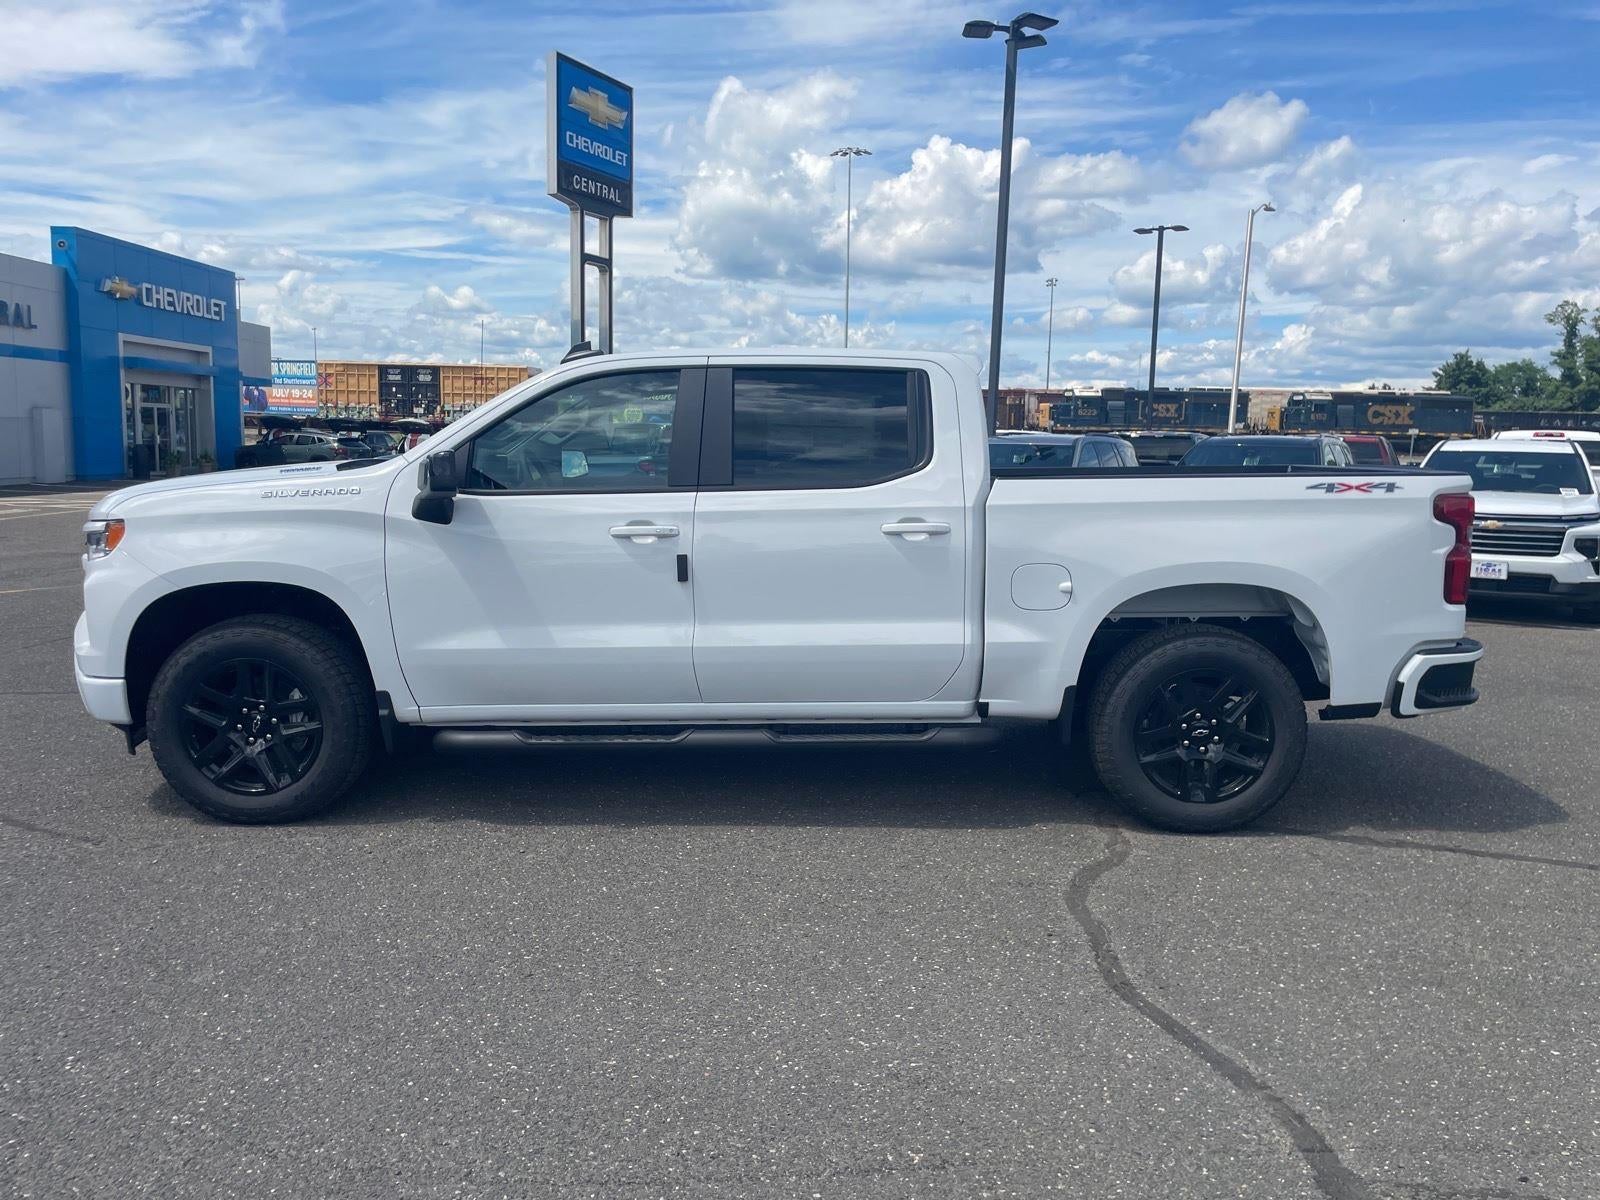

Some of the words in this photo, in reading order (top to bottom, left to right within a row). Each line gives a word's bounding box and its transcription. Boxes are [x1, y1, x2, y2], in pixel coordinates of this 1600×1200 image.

[566, 130, 628, 167] CHEVROLET
[573, 174, 621, 203] CENTRAL
[142, 282, 227, 321] CHEVROLET
[280, 362, 315, 376] SPRINGFIELD
[272, 388, 289, 398] JULY
[291, 389, 312, 399] 19-24
[1367, 404, 1416, 425] CSX
[260, 486, 362, 499] SILVERADO
